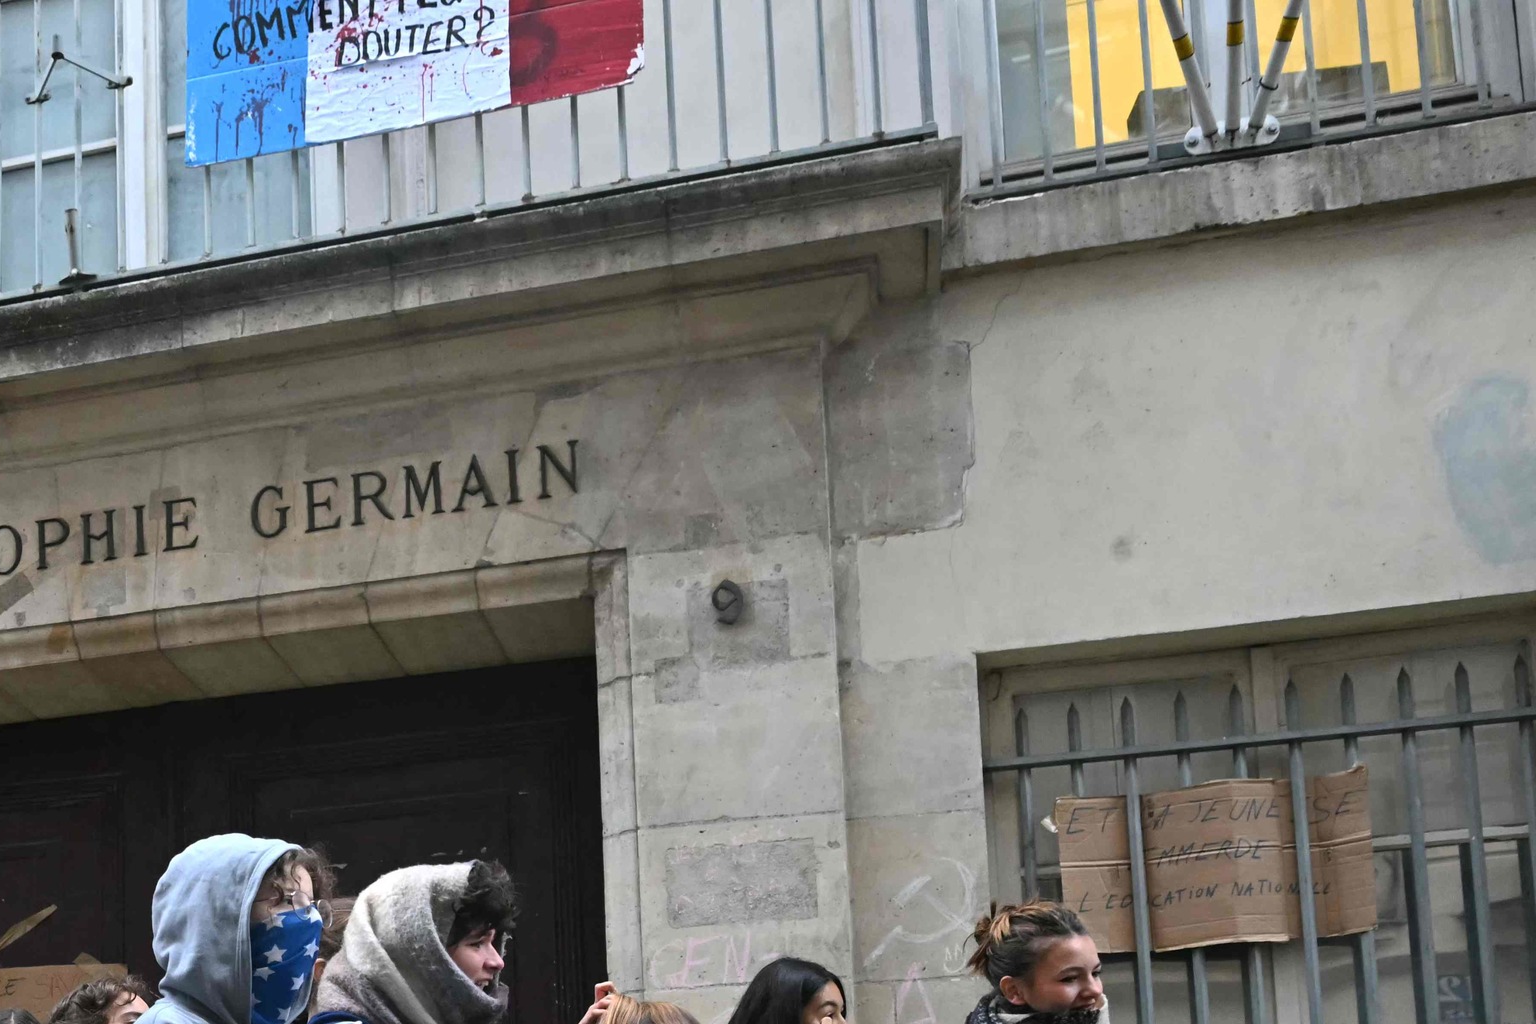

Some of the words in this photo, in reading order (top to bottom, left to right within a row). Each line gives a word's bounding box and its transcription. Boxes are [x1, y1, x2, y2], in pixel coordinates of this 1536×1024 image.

[250, 439, 582, 540] GERMAIN
[1066, 806, 1119, 834] ET
[1188, 789, 1368, 826] JEUNESE
